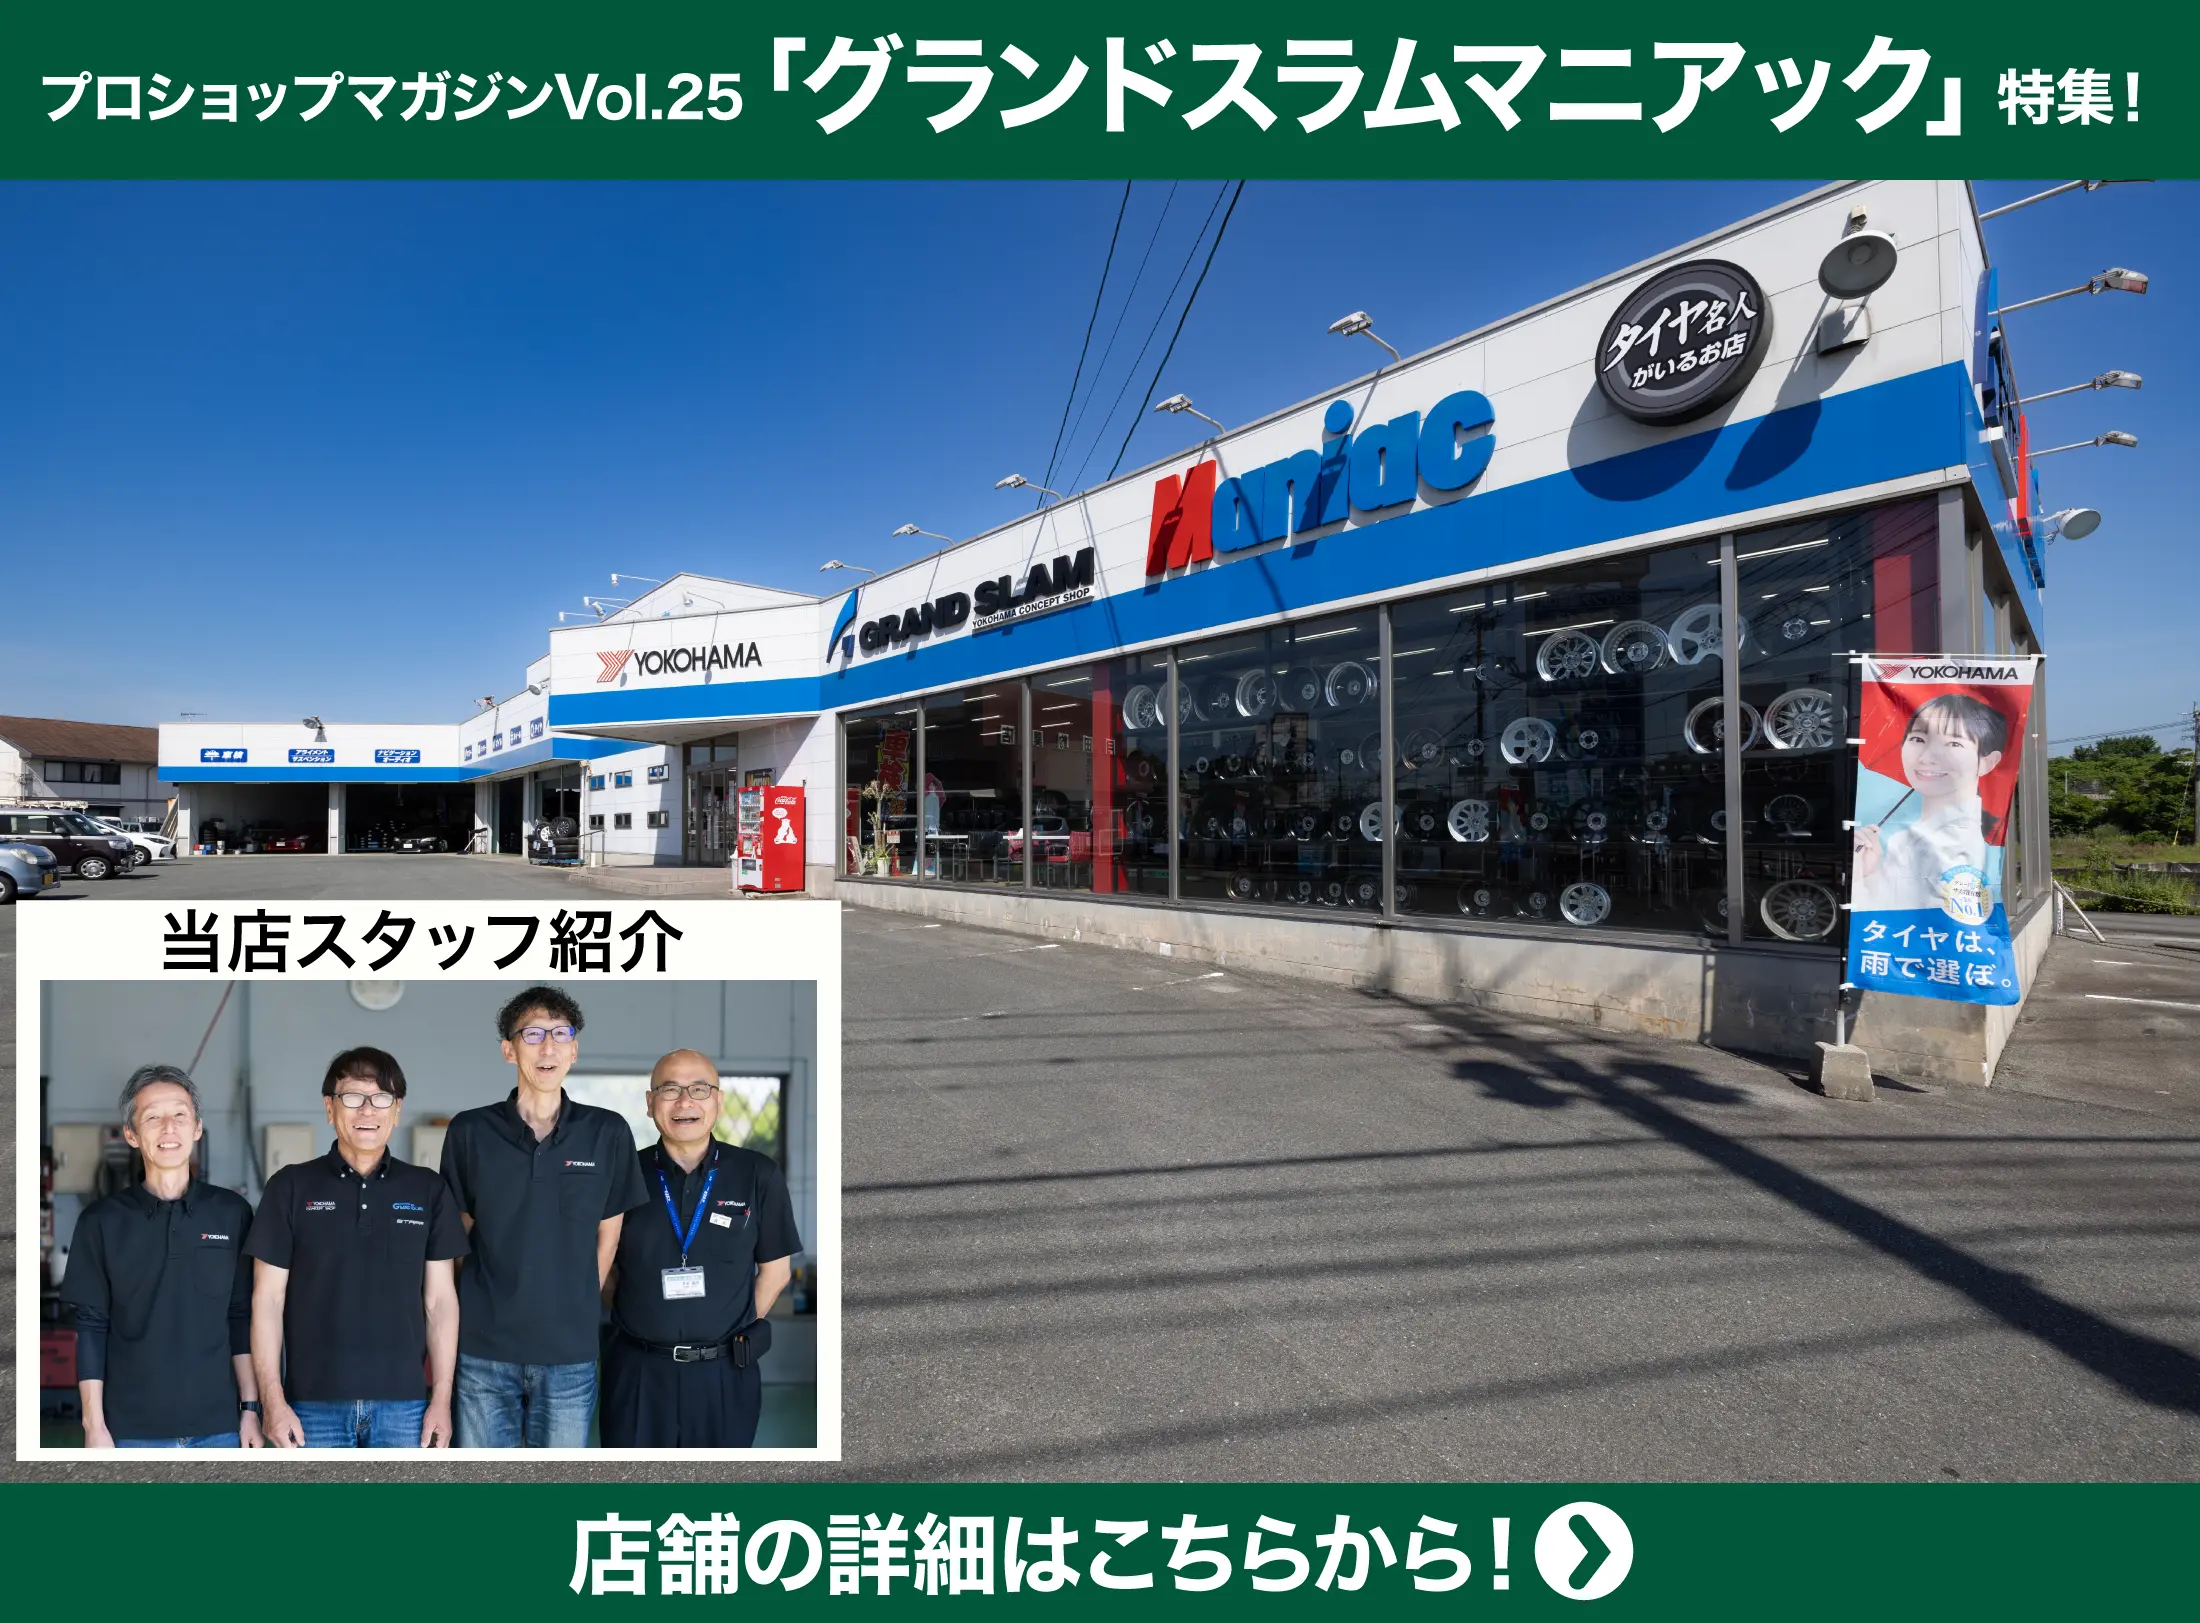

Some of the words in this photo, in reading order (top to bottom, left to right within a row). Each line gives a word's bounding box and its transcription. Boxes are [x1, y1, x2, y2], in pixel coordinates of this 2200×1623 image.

[1602, 291, 1758, 372] タイヤ名人
[1631, 332, 1747, 388] がいるお店
[1144, 389, 1496, 577] Maniac
[858, 591, 971, 651] GRAND
[973, 546, 1095, 616] SLAM
[972, 608, 1017, 629] YOKOHAMA
[1018, 595, 1061, 615] CONCEPT
[1063, 587, 1090, 603] SHOP
[634, 641, 763, 677] YOKOHAMA
[1909, 664, 2019, 681] YOKOHAMA
[1863, 919, 1996, 956] タイヤは、
[1860, 949, 2012, 988] 雨で選ぼ。
